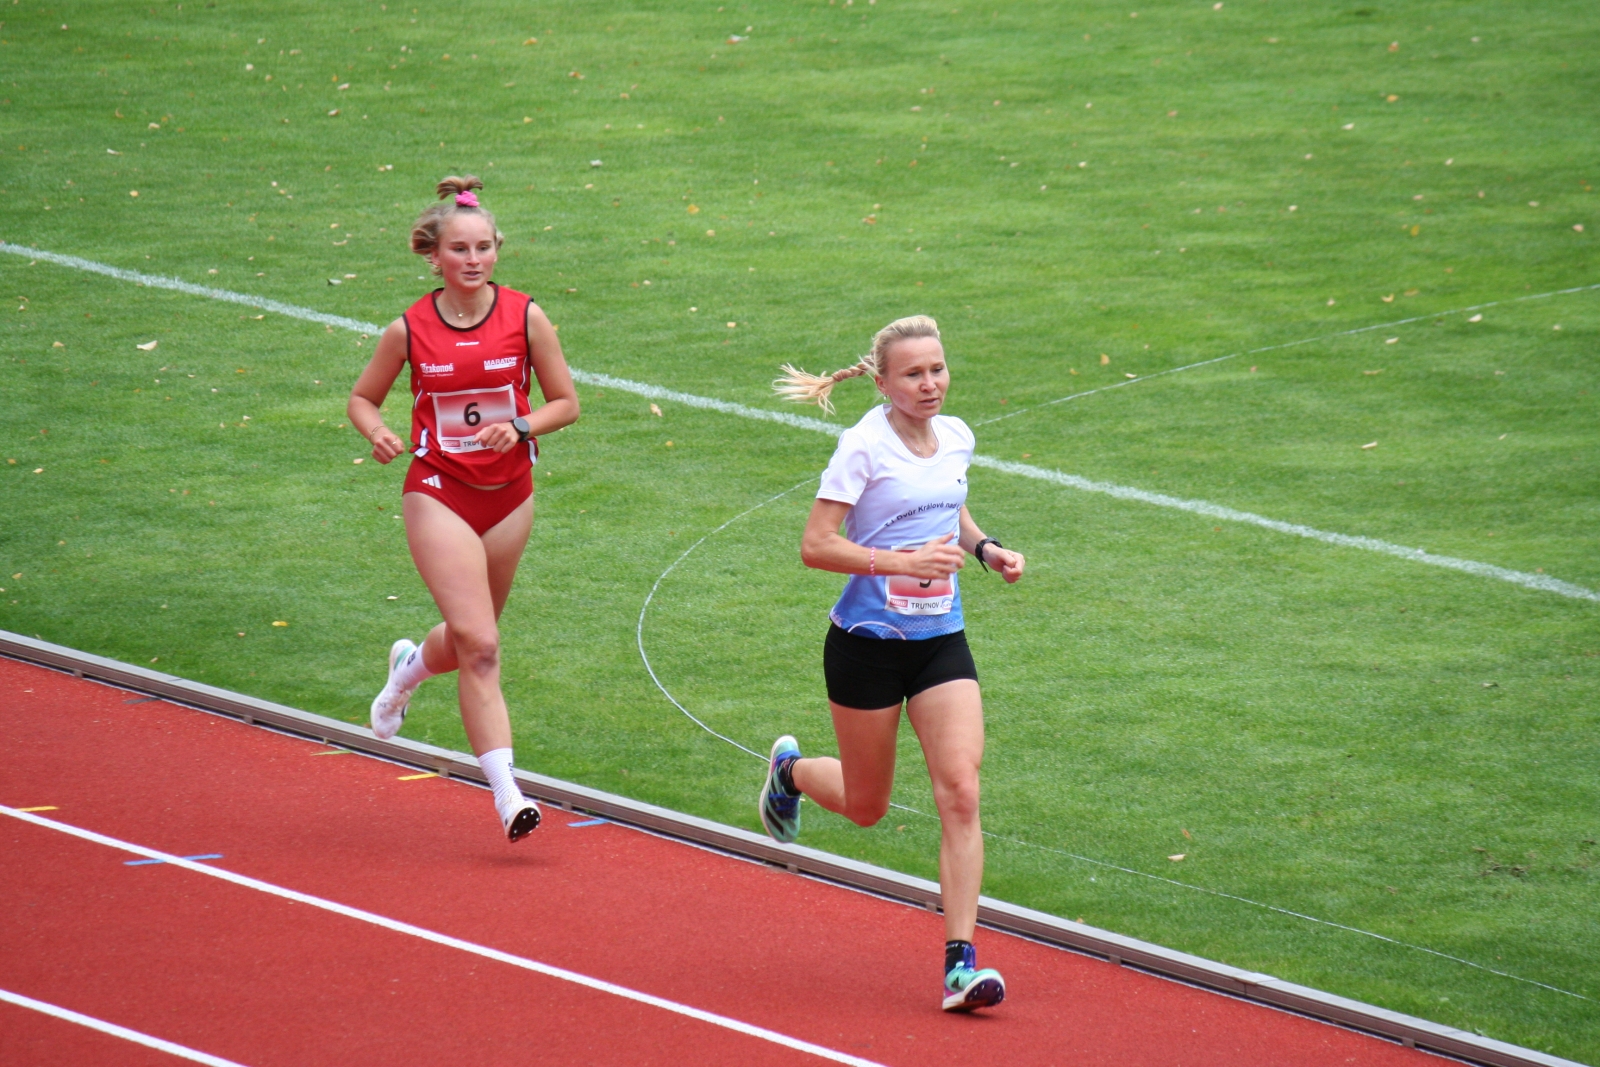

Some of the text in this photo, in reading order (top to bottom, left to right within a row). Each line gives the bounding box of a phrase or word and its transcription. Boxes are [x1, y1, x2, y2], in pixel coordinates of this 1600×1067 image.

[484, 357, 517, 366] MARATON
[463, 402, 481, 427] 6
[918, 501, 944, 513] Králové
